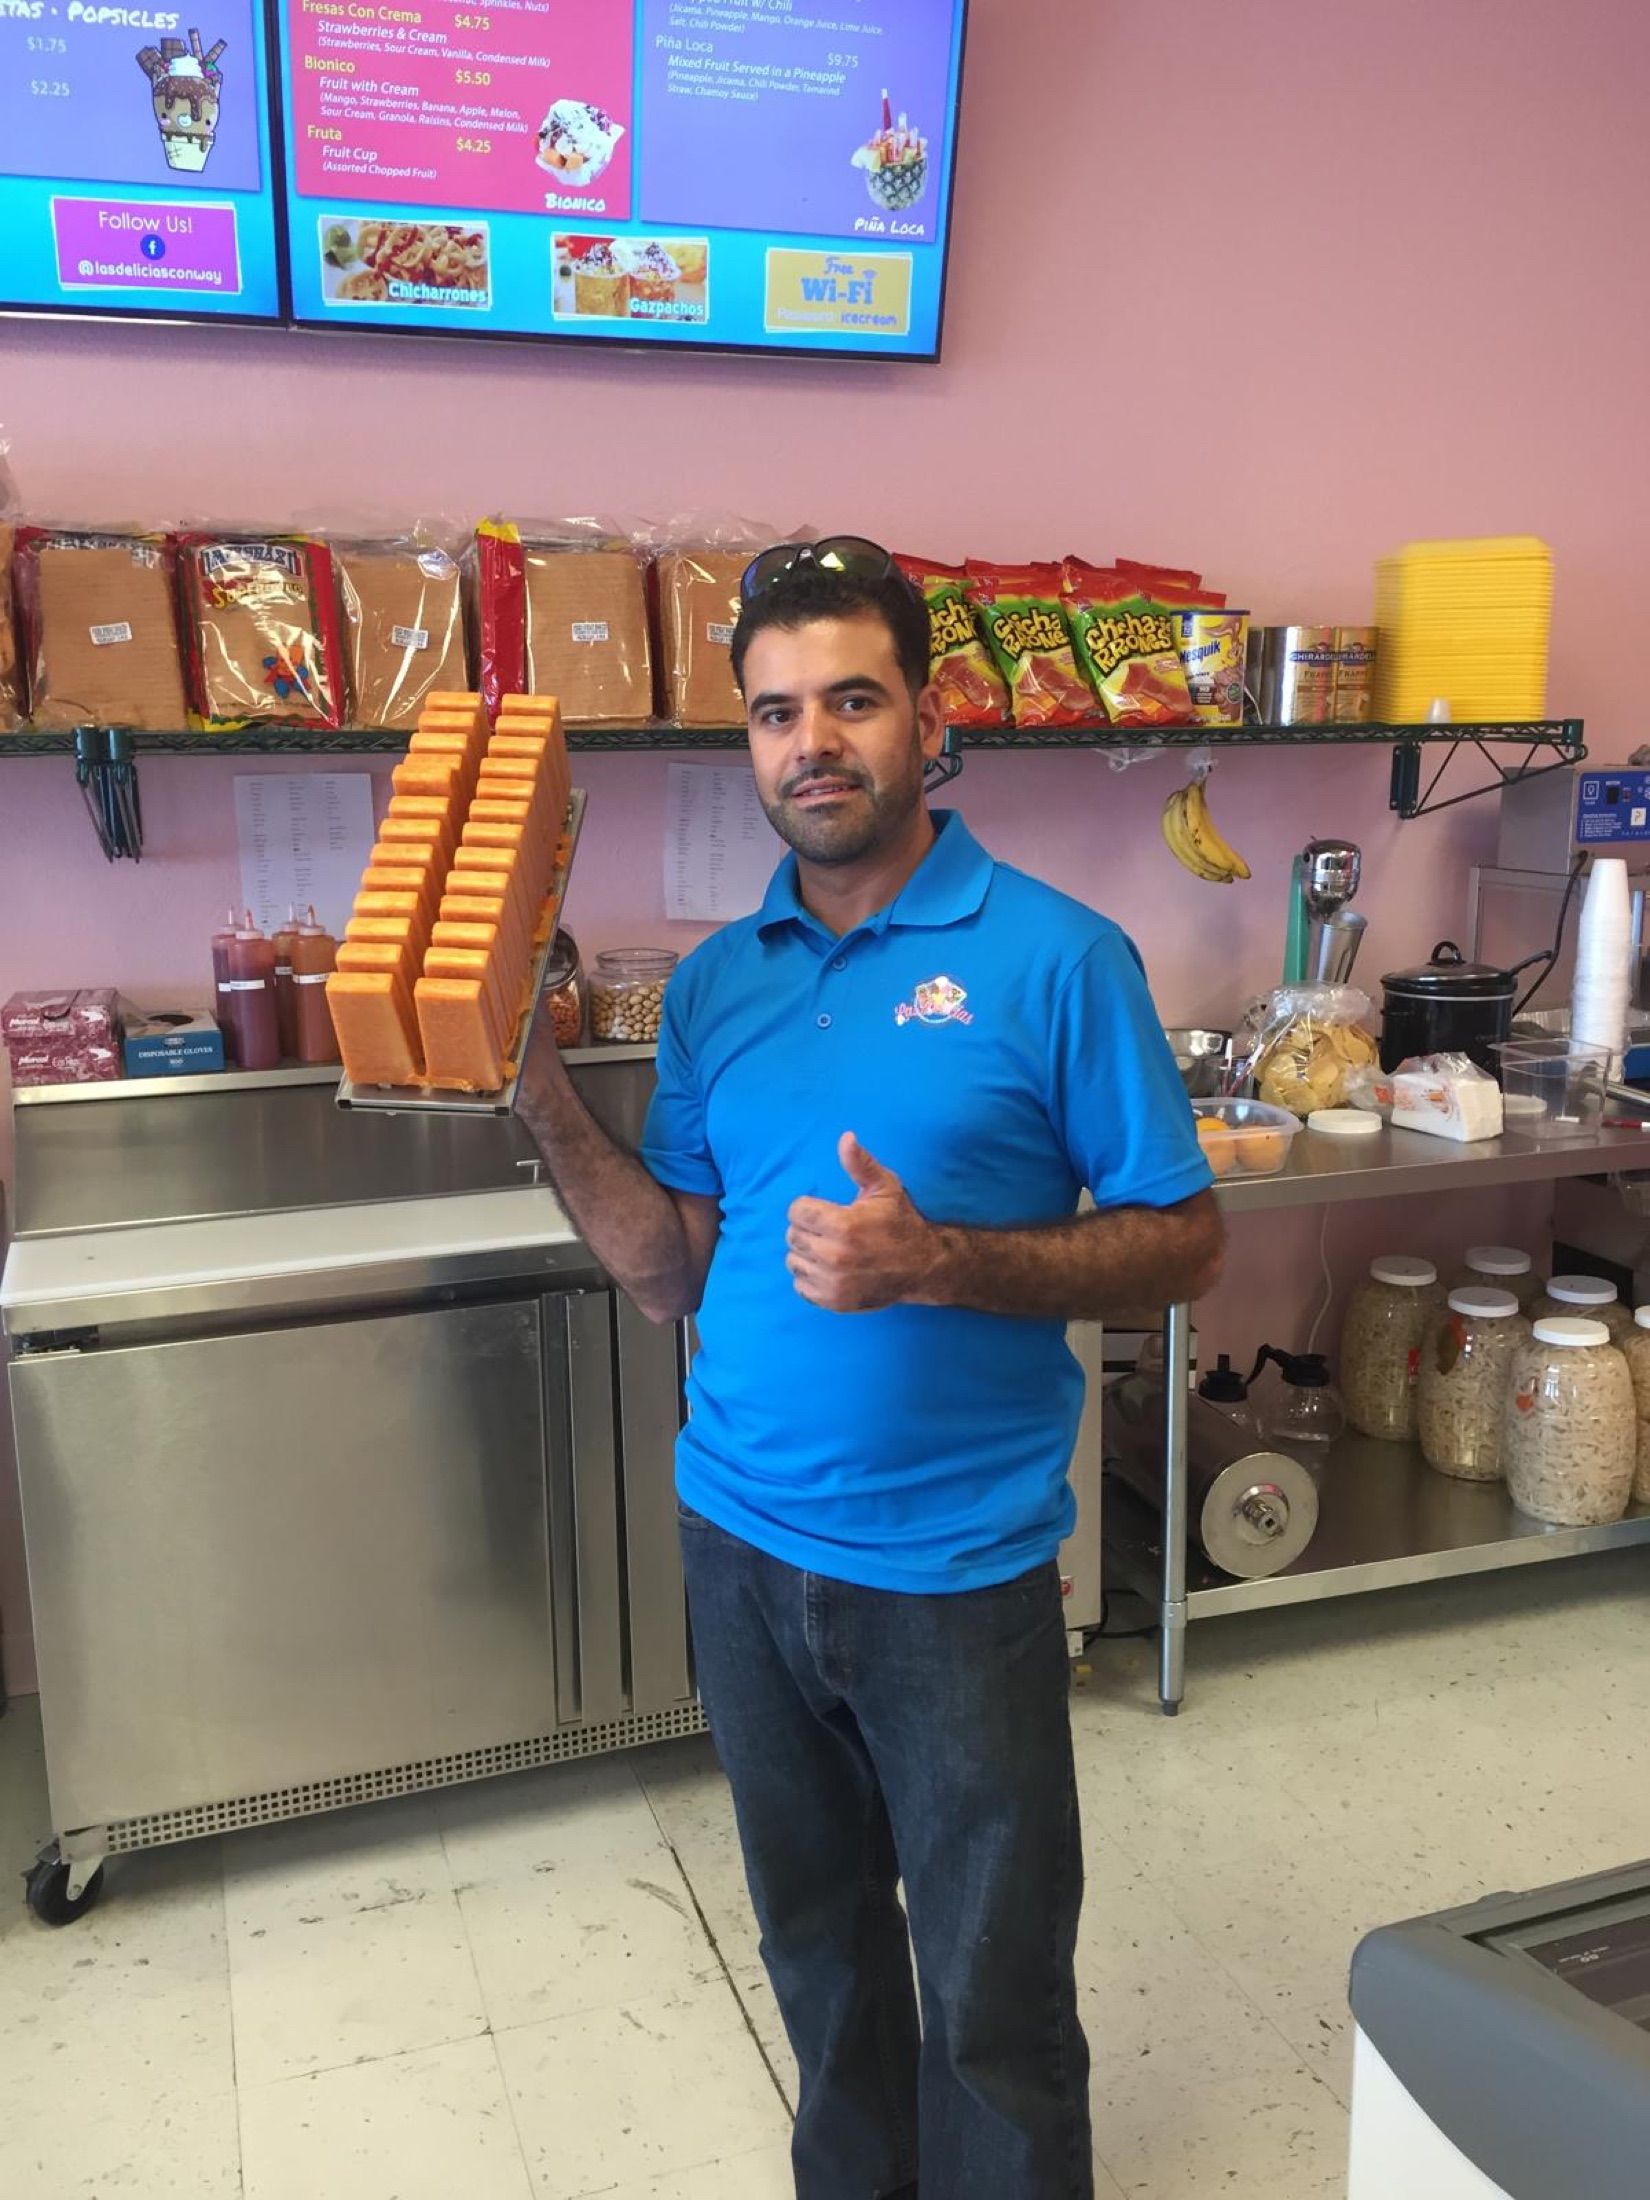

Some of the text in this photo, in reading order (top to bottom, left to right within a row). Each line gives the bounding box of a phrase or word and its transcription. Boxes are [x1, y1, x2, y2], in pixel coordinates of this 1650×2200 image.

[68, 1, 180, 29] POPSICLES
[303, 0, 422, 23] Fresas Con Crema
[318, 20, 447, 44] Strawberries & Cream
[454, 13, 490, 31] $4.75
[27, 36, 67, 54] $1.75
[686, 39, 713, 53] Loca
[304, 54, 356, 73] Bionico
[384, 43, 406, 53] Sour
[407, 45, 440, 57] Cream,
[476, 51, 527, 65] Condensed
[528, 56, 551, 68] Milk)
[455, 68, 491, 86] $5.50
[668, 56, 701, 69] Mixed
[705, 59, 730, 72] Fruit
[732, 61, 770, 75] Served
[772, 67, 783, 77] in
[793, 67, 846, 84] Pineapple
[31, 80, 71, 97] $2.25
[320, 76, 420, 97] Fruit with Cream
[320, 105, 343, 117] Sour
[344, 108, 376, 120] Cream,
[454, 118, 505, 131] Condensed
[506, 122, 529, 134] Milk)
[307, 124, 342, 141] Fruta
[322, 145, 378, 163] Fruit Cup
[456, 137, 491, 154] $4.25
[322, 161, 438, 179] (Assorted Chopped Fruit)
[545, 192, 606, 212] BIONICO
[99, 211, 193, 233] Follow Us!
[854, 216, 925, 236] PIÑA LOCA
[78, 259, 222, 285] @lasdeliciasconway
[824, 256, 853, 274] Free
[388, 281, 487, 302] Chicharrones
[801, 277, 873, 304] Wi-Fi
[629, 296, 704, 316] Gazpachos
